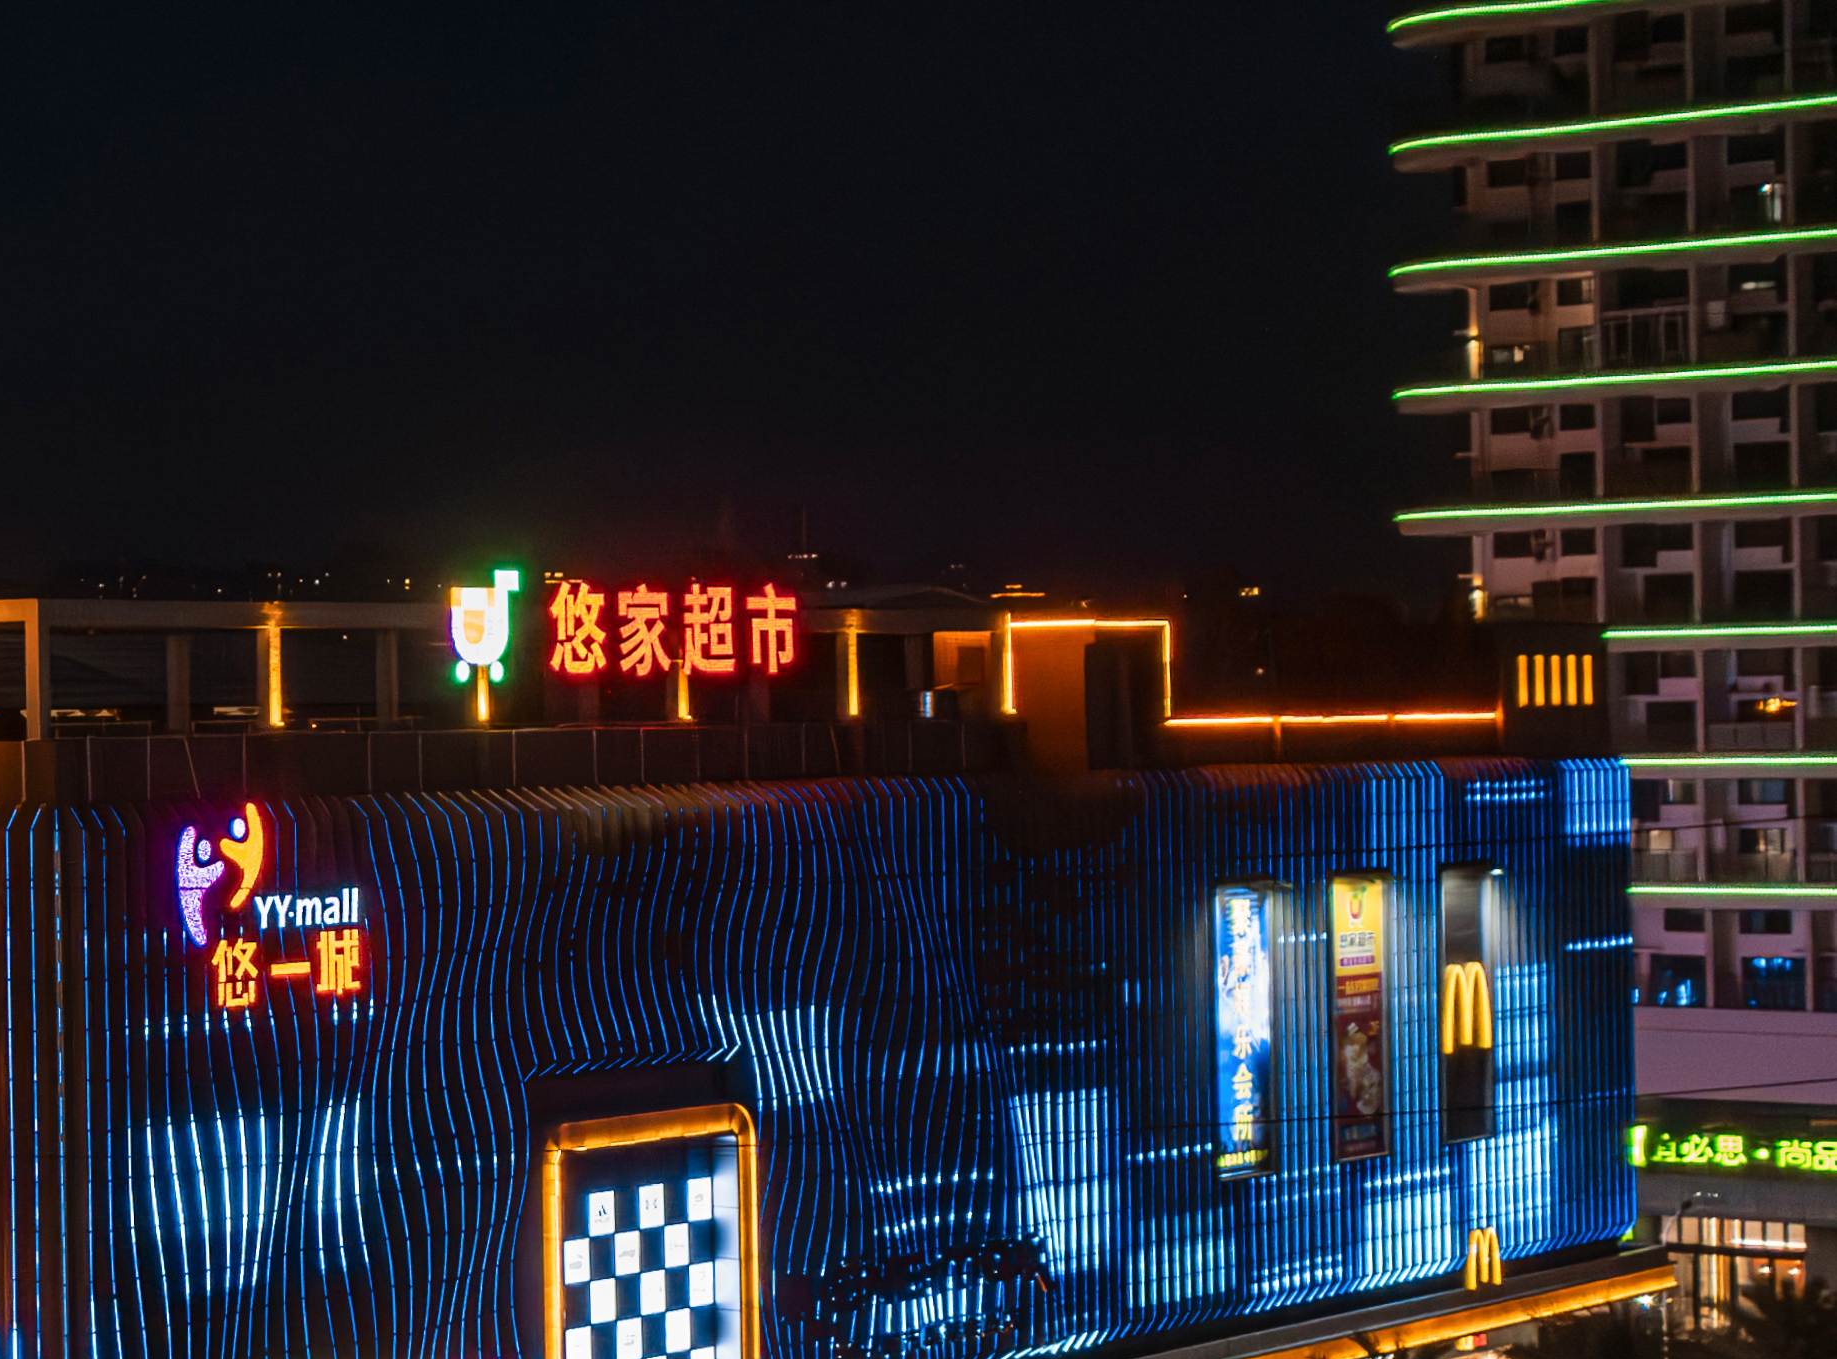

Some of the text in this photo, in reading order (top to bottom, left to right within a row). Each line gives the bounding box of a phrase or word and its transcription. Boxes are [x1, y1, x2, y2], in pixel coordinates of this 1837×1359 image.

[550, 581, 797, 676] 悠家超市
[211, 929, 361, 1007] 悠一城
